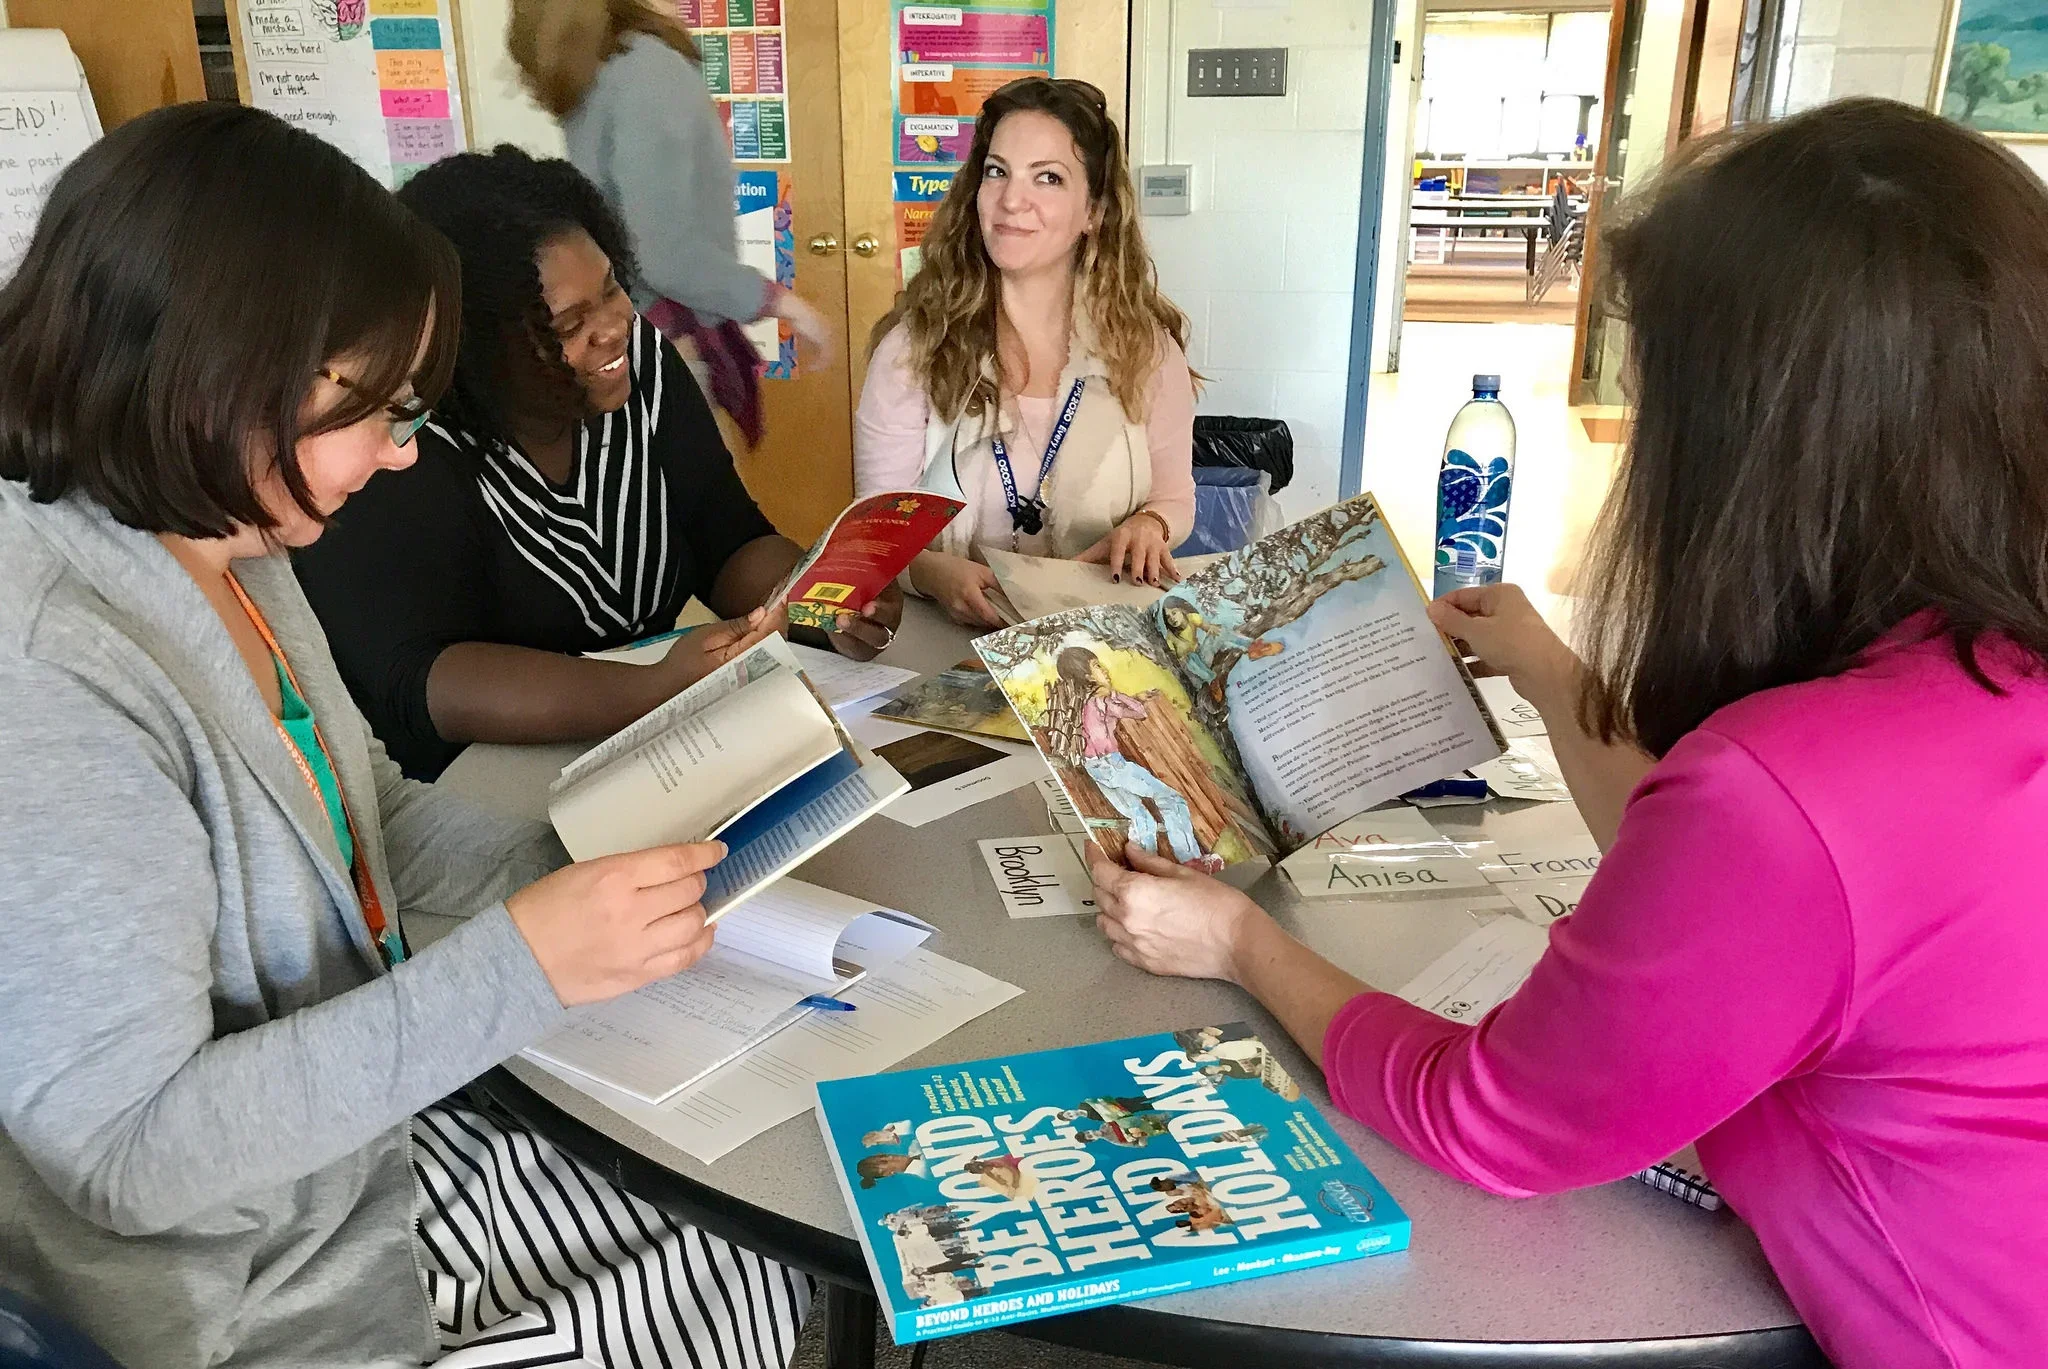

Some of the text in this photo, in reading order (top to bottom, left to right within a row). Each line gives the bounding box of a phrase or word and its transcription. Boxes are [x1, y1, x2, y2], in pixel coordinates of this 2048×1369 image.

[908, 13, 957, 21] INTERROGATIVE
[253, 42, 275, 57] This
[910, 69, 946, 77] IMPERATIVE
[910, 123, 954, 131] EXCLAMATORY
[28, 152, 64, 175] past
[1051, 424, 1067, 448] Every
[1314, 832, 1390, 849] Ava
[994, 845, 1060, 906] Brooklyn
[1327, 864, 1448, 889] Anisa
[1123, 1050, 1321, 1241] HOLIDAYS
[993, 1106, 1152, 1272] HEROES
[915, 1115, 1064, 1288] BEYOND
[1112, 1158, 1239, 1247] AND
[1213, 1266, 1229, 1276] Lee
[915, 1280, 1120, 1329] BEYOND HEROES AND HOLIDAYS
